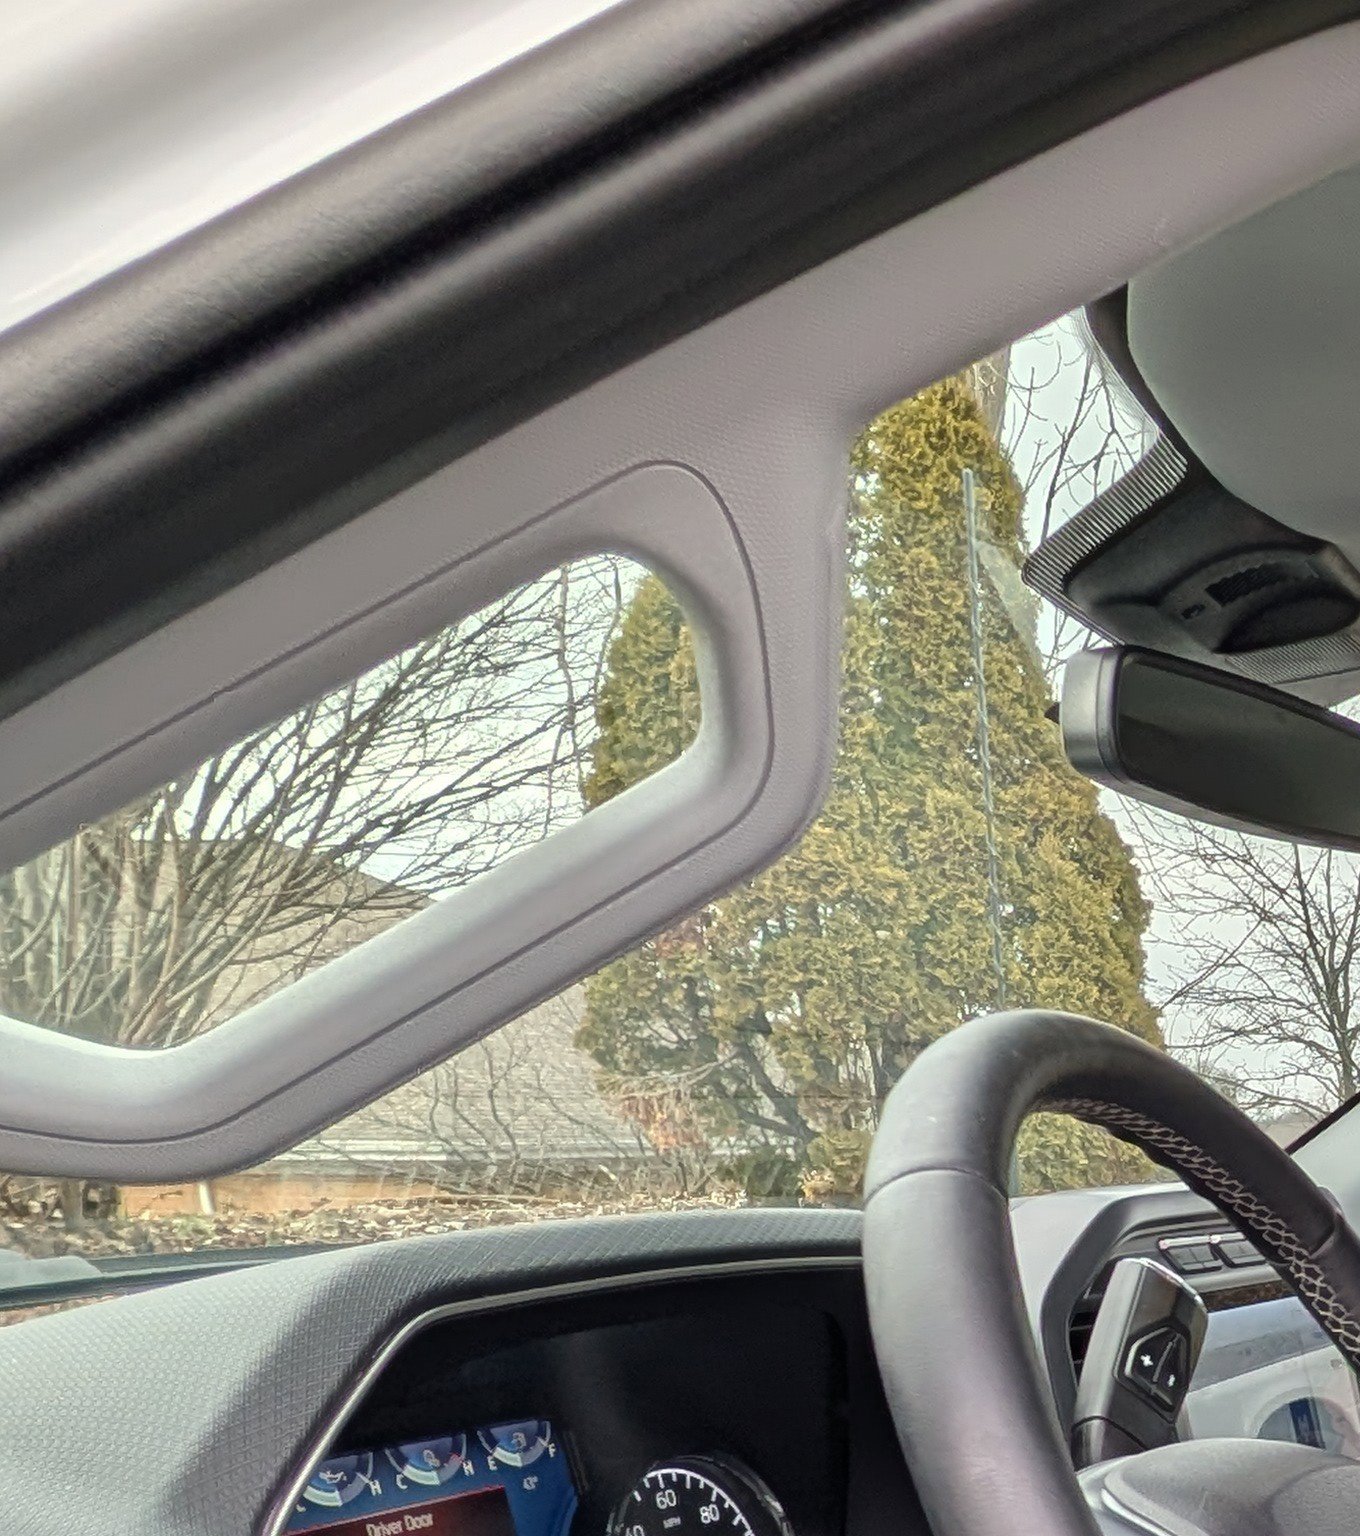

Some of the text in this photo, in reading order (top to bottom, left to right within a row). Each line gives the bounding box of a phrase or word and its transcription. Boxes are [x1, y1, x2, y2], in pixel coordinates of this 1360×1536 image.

[656, 1489, 677, 1510] 60
[404, 1513, 434, 1532] Door
[700, 1504, 720, 1524] 80
